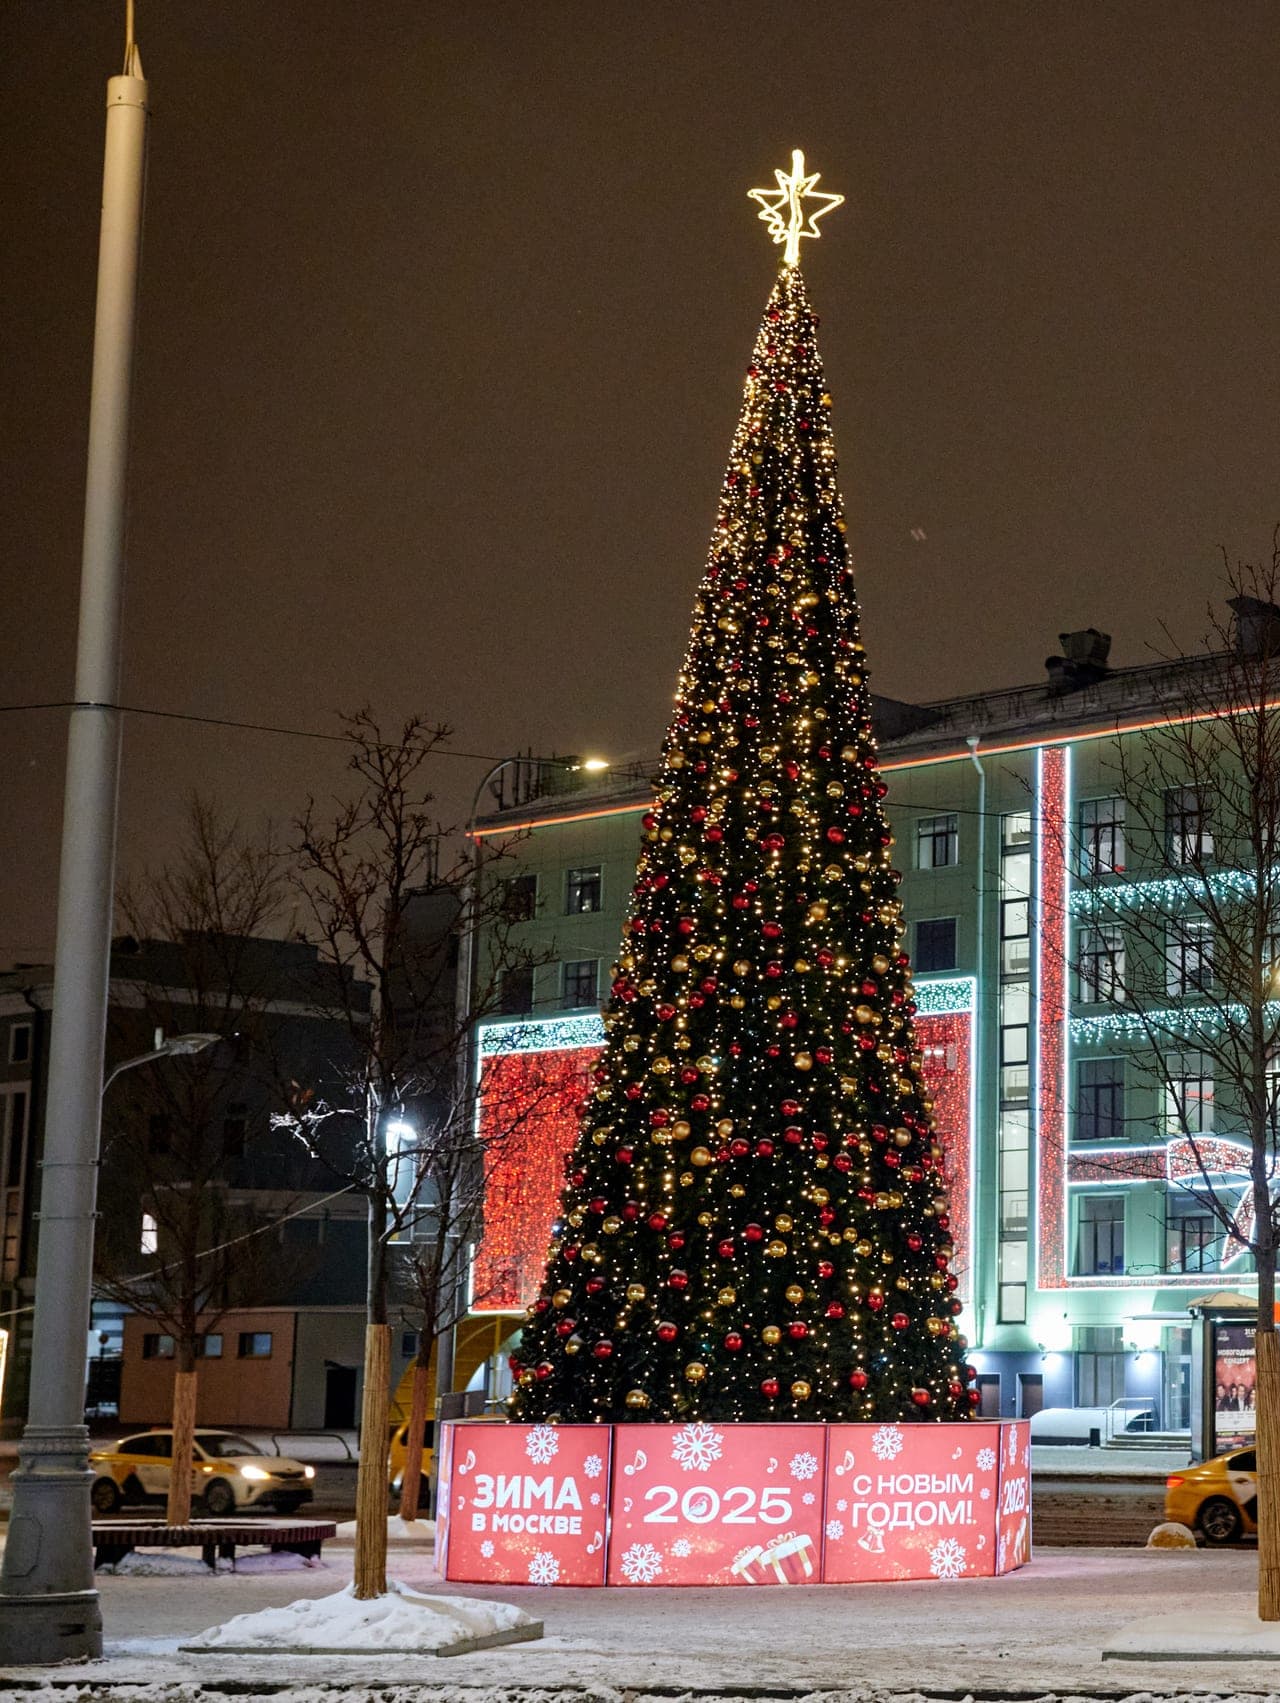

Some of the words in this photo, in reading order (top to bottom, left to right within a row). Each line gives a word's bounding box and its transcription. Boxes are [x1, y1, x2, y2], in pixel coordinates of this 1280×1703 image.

[472, 1474, 583, 1510] ЗИМА
[853, 1474, 872, 1495] С
[877, 1473, 974, 1495] НОВЫМ
[1003, 1477, 1026, 1516] 2025
[643, 1485, 793, 1524] 2025
[852, 1500, 973, 1531] ГОДОМ!
[471, 1512, 487, 1532] В
[491, 1513, 583, 1535] МОСКВЕ
